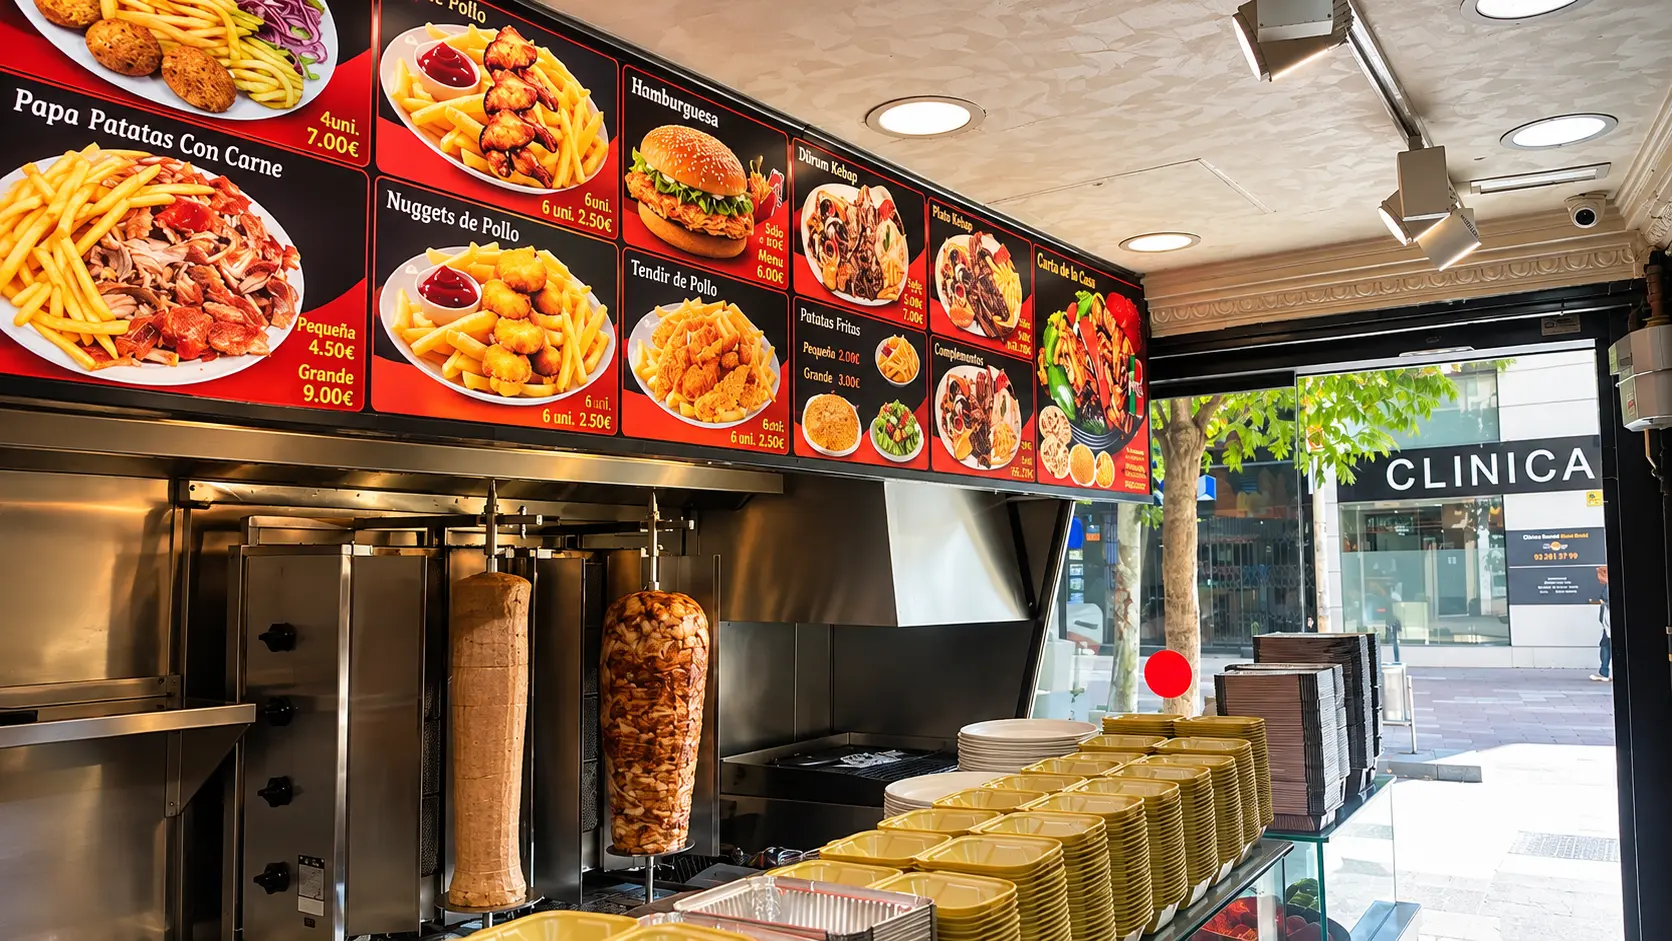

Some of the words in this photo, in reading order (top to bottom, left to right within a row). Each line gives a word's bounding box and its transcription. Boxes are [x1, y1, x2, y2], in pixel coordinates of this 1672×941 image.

[631, 76, 719, 128] Hamburguesa
[13, 88, 79, 126] Papa
[88, 108, 174, 150] Patatas
[179, 133, 219, 162] Con
[224, 145, 283, 178] Carne
[320, 111, 360, 137] 4uni.
[307, 127, 360, 158] 7.00€
[798, 145, 829, 172] Dürum
[584, 192, 612, 213] 6uni.
[386, 189, 456, 225] Nuggets
[459, 211, 478, 232] de
[482, 216, 520, 242] Pollo
[542, 200, 550, 214] 6
[553, 206, 575, 222] uni.
[578, 209, 612, 232] 2.50€
[758, 249, 784, 268] Menu
[631, 259, 671, 284] Tendir
[673, 271, 687, 289] de
[690, 275, 718, 297] Pollo
[757, 265, 784, 284] 6.00€
[1060, 262, 1070, 279] de
[297, 316, 356, 340] Pequeña
[800, 307, 834, 330] Patatas
[308, 339, 356, 360] 4.50€
[298, 363, 355, 385] Grande
[803, 367, 833, 384] Grande
[838, 373, 860, 389] 3.00€
[303, 384, 354, 407] 9.00€
[542, 408, 551, 423] 6
[553, 411, 575, 425] uni.
[579, 412, 612, 430] 2.50€
[731, 430, 738, 443] 6
[758, 433, 785, 449] 2.50€
[1386, 447, 1596, 491] CLINICA
